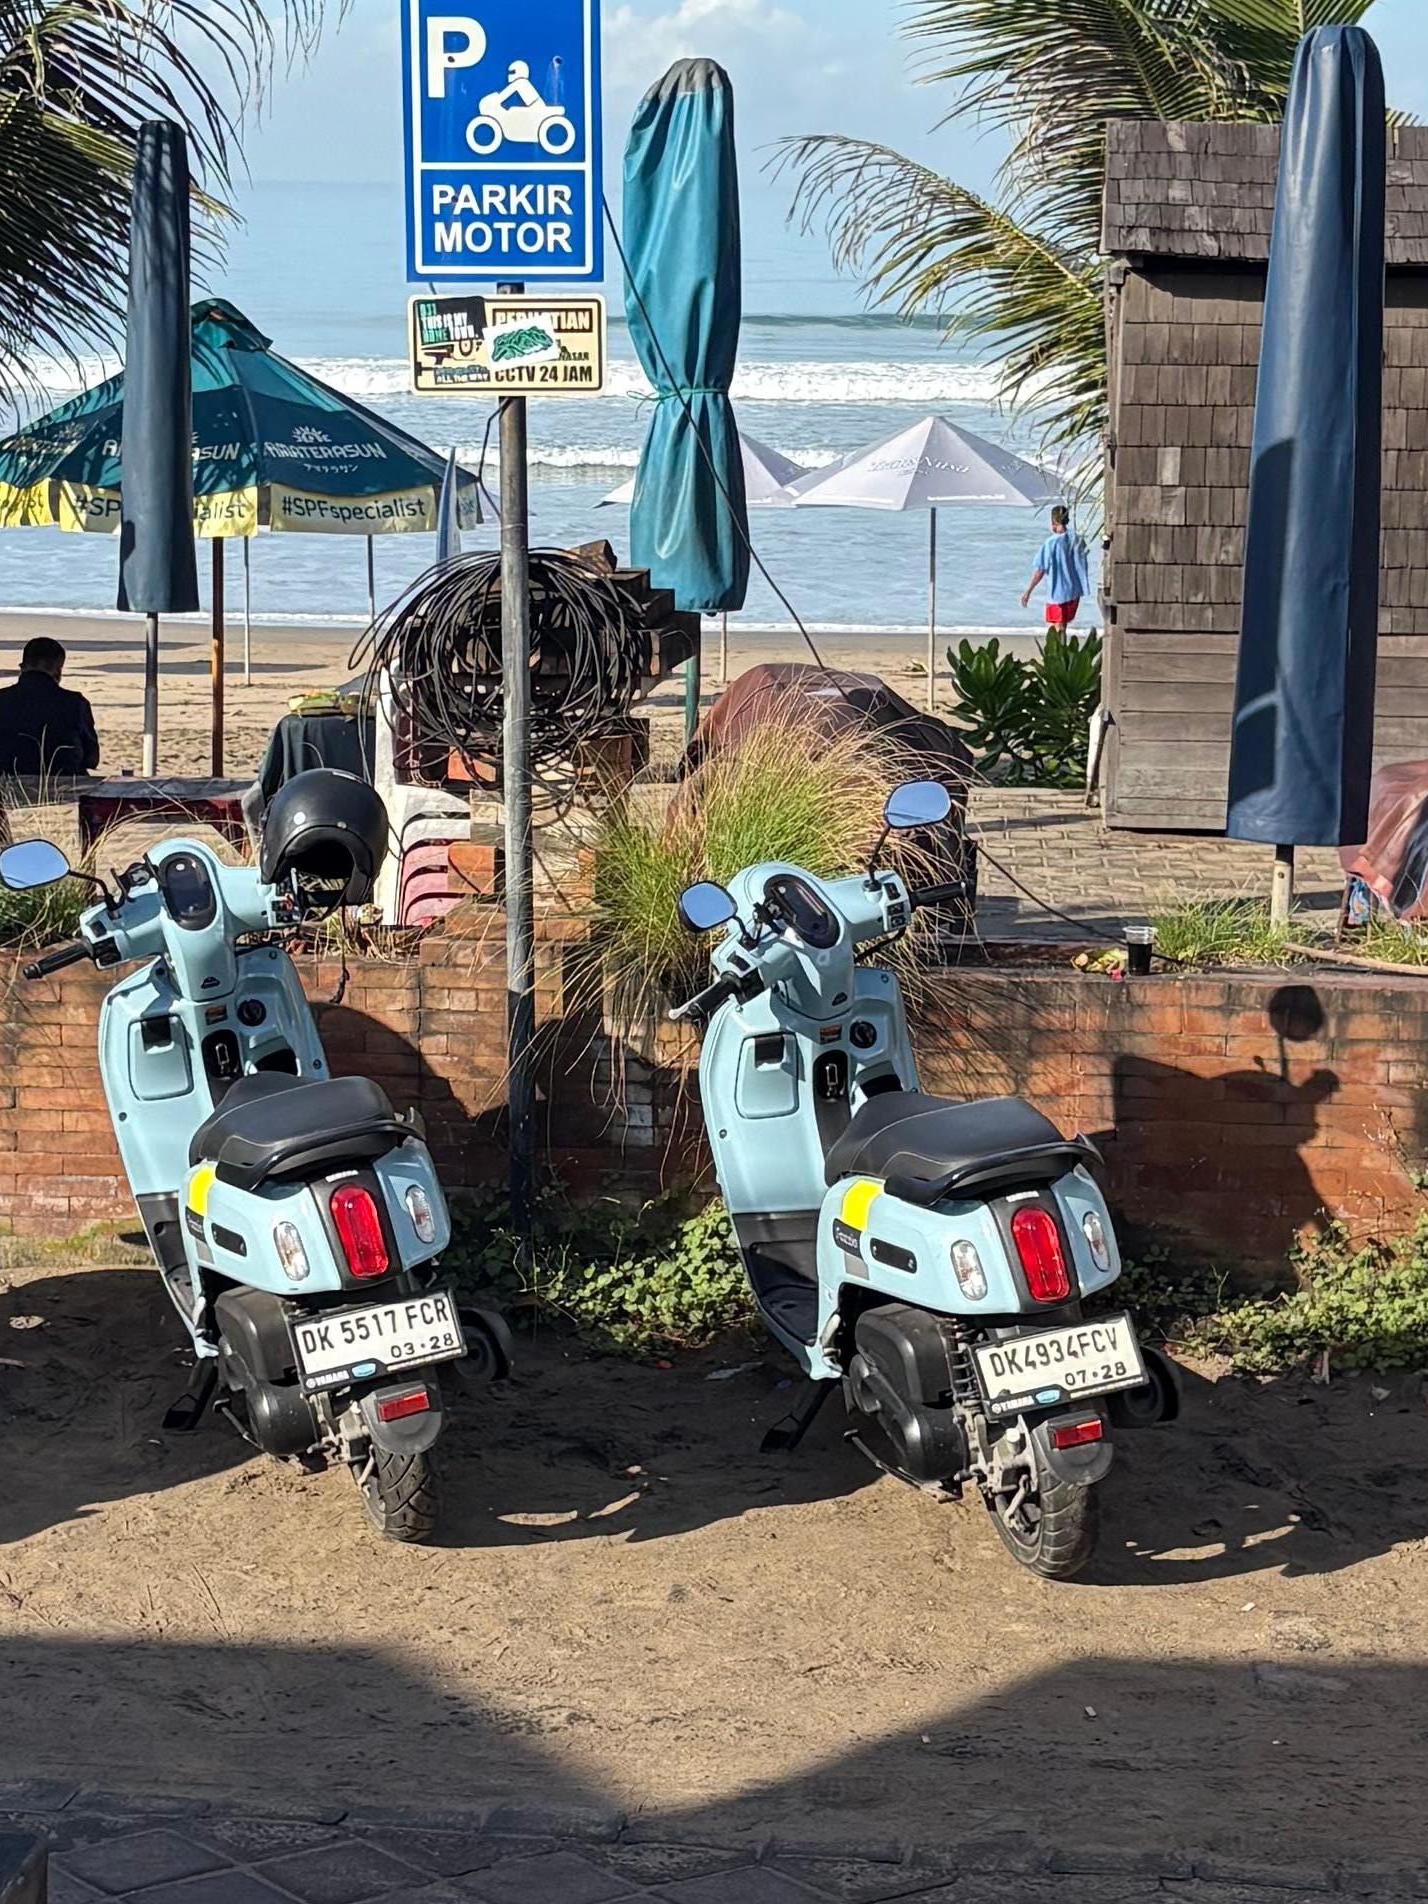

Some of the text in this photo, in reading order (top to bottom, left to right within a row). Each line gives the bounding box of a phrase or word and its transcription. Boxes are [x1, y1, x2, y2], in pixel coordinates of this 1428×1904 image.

[427, 16, 487, 98] P
[432, 184, 573, 215] PARKIR
[433, 221, 572, 253] MOTOR
[540, 365, 558, 382] 24
[562, 365, 593, 382] JAM
[282, 497, 427, 525] #SPFspecialist
[301, 1298, 451, 1355] DK 5517 FCR
